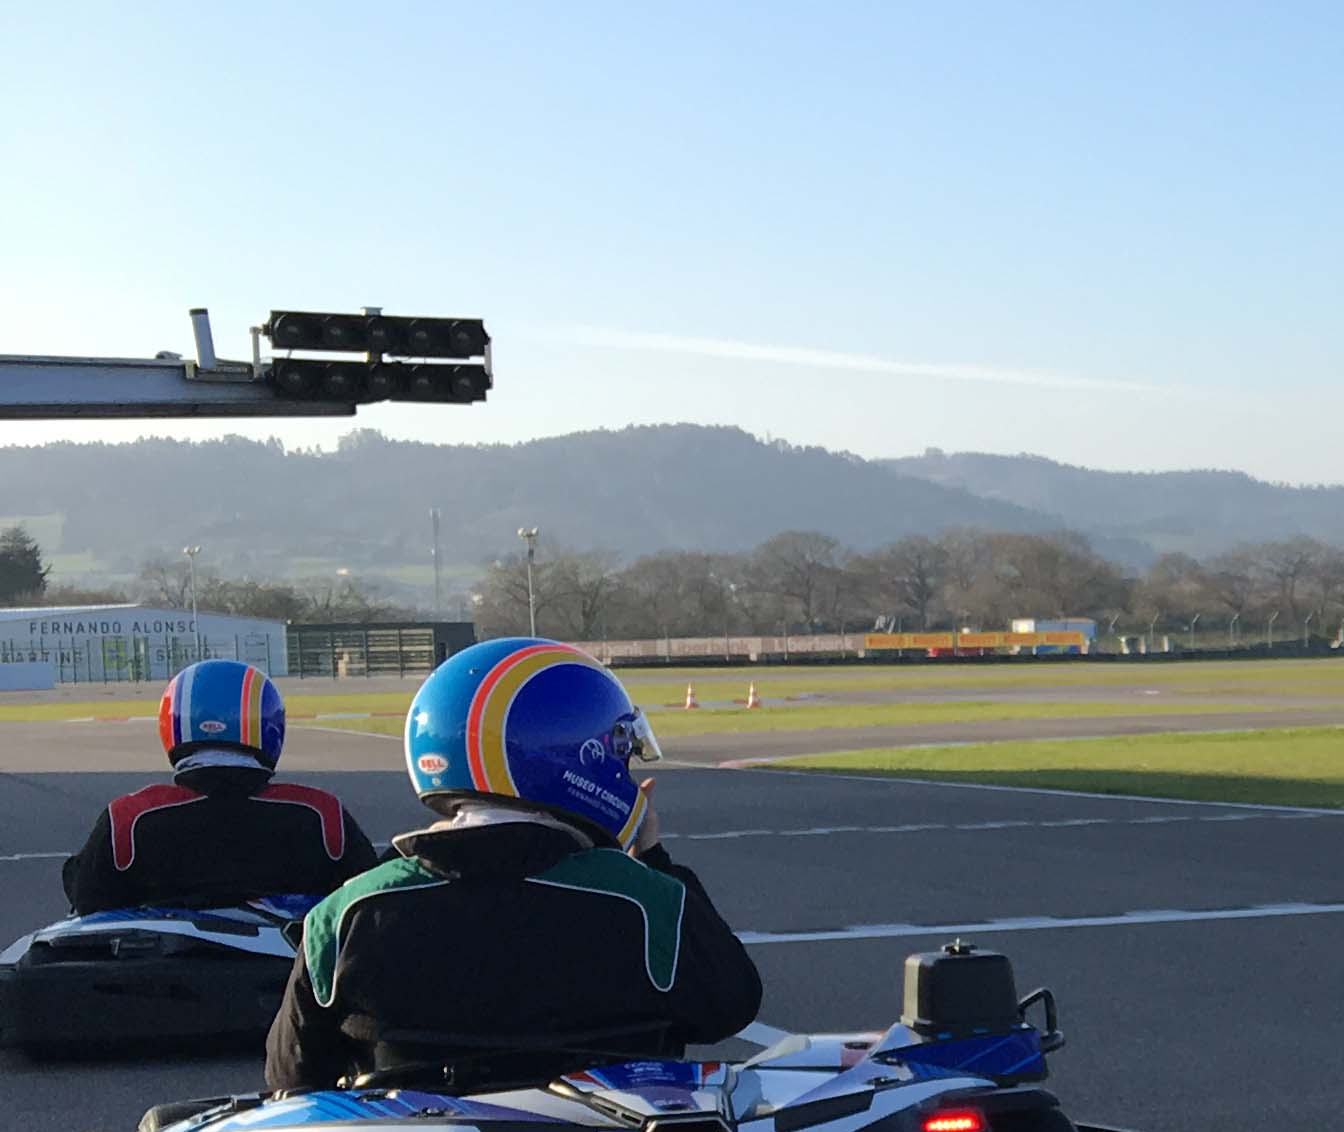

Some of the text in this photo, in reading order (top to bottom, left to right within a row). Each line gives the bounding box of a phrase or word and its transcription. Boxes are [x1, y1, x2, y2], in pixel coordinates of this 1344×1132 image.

[30, 622, 122, 634] FERNANDO
[421, 759, 444, 769] BELL
[563, 770, 596, 793] MUSEO
